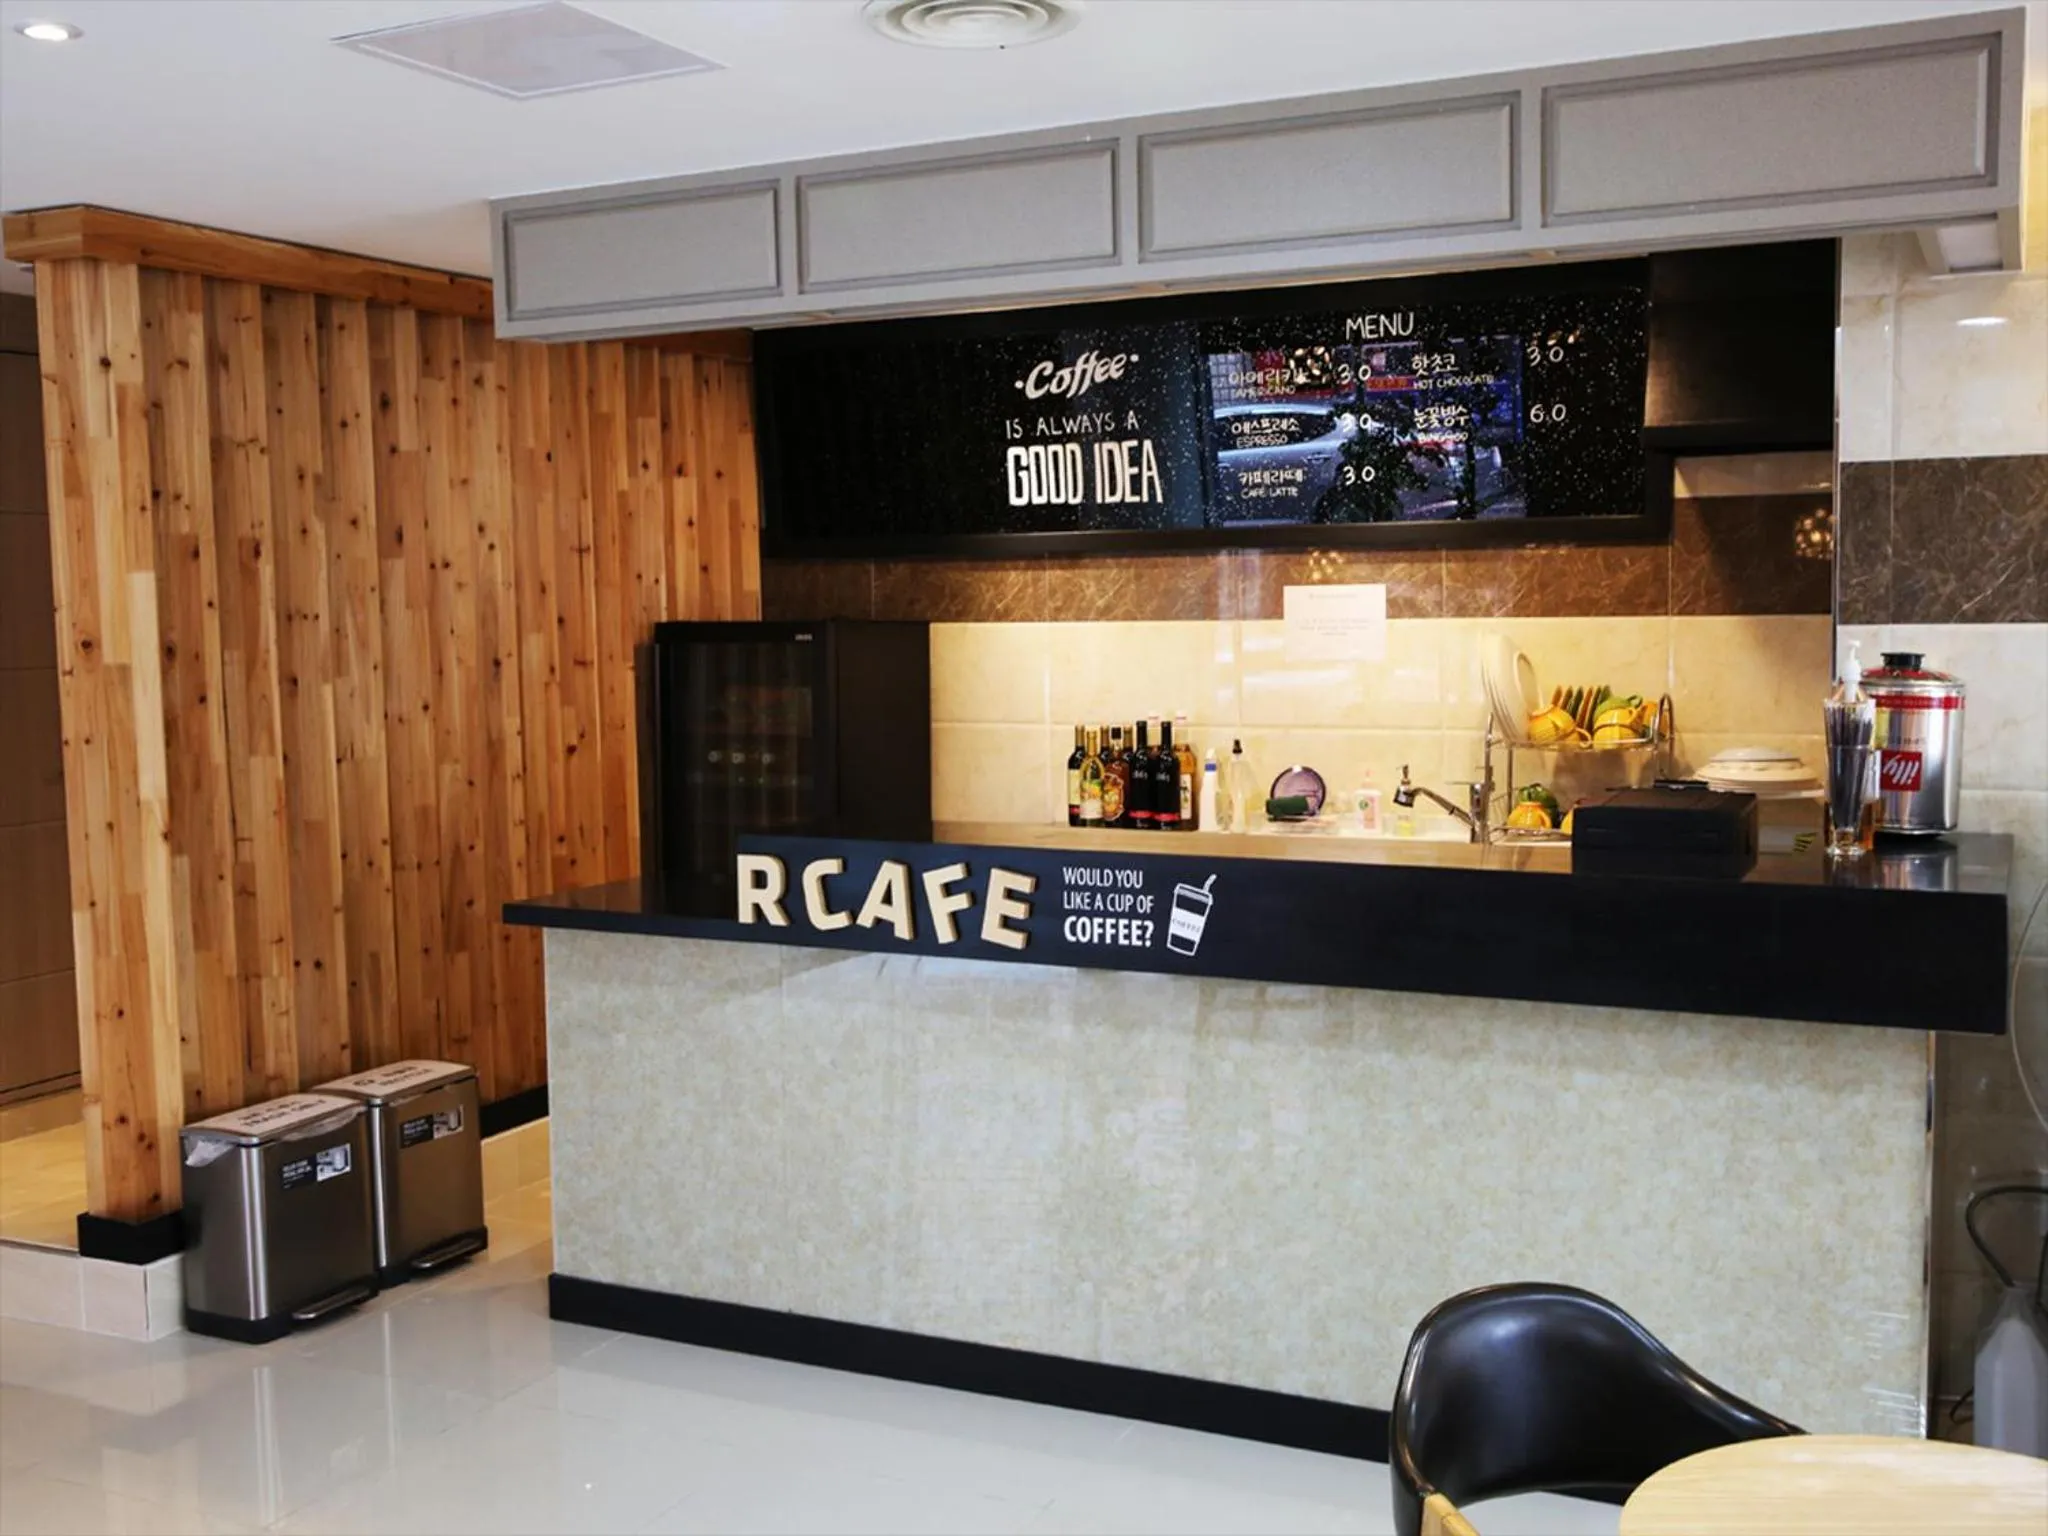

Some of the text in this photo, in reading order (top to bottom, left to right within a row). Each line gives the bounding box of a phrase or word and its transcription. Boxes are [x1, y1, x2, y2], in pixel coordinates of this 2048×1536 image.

[1345, 312, 1414, 340] MENU
[1411, 352, 1460, 377] 핫초코
[1413, 379, 1434, 391] HOT
[1006, 409, 1140, 440] IS ALWAYS A
[1231, 417, 1301, 435] 에스프레소
[1413, 403, 1470, 429] 눈꽃빙수
[1006, 439, 1164, 506] GOOD IDEA
[1884, 754, 1920, 785] illy
[1062, 866, 1144, 889] WOULD YOU
[1063, 891, 1155, 914] LIKE A CUP OF
[1063, 915, 1155, 948] COFFEE?
